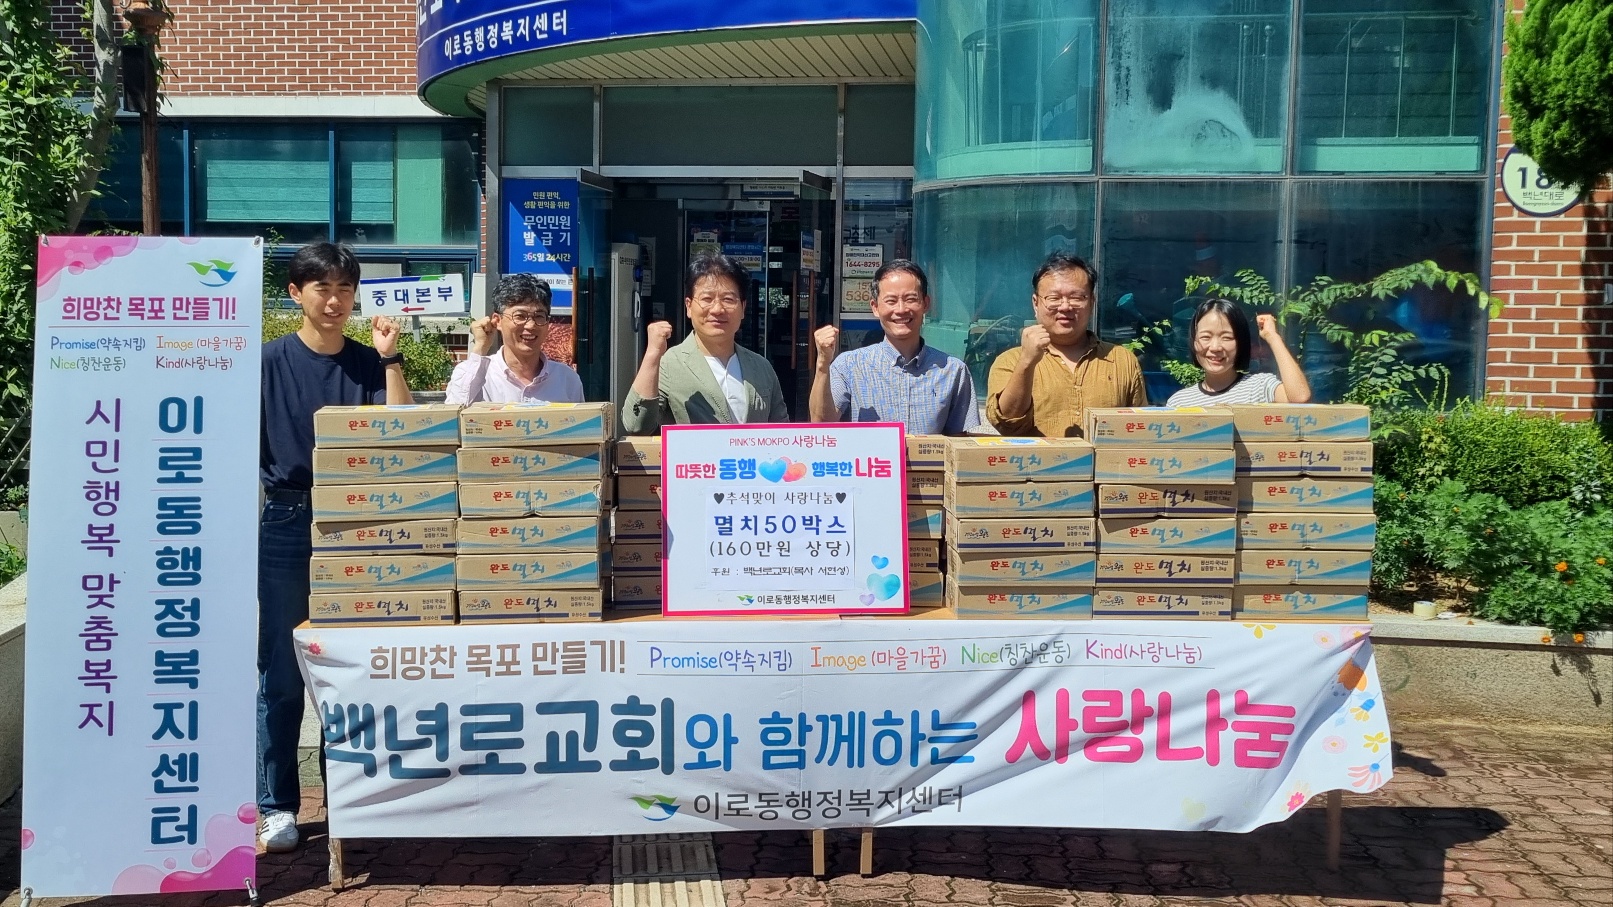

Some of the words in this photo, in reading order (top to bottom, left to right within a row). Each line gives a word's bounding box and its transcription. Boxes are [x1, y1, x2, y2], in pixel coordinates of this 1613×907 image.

[445, 9, 567, 60] 이로동행정복지센터
[1523, 191, 1564, 200] 백년대로
[524, 201, 536, 209] 생활
[537, 201, 556, 209] 편익을
[558, 201, 570, 209] 위한
[524, 216, 571, 229] 무인민원
[523, 252, 544, 262] 365일
[546, 253, 571, 262] 24시간
[372, 286, 453, 306] 중대본부
[62, 296, 122, 321] 희망찬
[128, 297, 166, 321] 목포
[172, 297, 236, 321] 만들기!
[50, 336, 146, 351] Promise(약속지킴)
[156, 336, 193, 351] Image
[196, 336, 247, 351] (마을가꿈)
[50, 356, 126, 372] Nice(칭찬운동)
[155, 356, 233, 371] Kind(사랑나눔)
[348, 420, 369, 430] 완도
[372, 418, 404, 436] 멸치
[494, 420, 513, 430] 완도
[516, 417, 548, 435] 멸치
[1126, 423, 1145, 432] 완도
[1148, 421, 1180, 438] 멸치
[1264, 416, 1283, 425] 완도
[1286, 414, 1317, 431] 멸치
[729, 438, 756, 447] PINK'S
[758, 437, 789, 446] MOKPO
[792, 435, 837, 448] 사랑나눔
[346, 457, 368, 467] 완도
[370, 454, 403, 472] 멸치
[491, 457, 511, 466] 완도
[513, 455, 546, 471] 멸치
[988, 456, 1007, 466] 완도
[1010, 453, 1041, 471] 멸치
[1127, 458, 1147, 467] 완도
[1150, 456, 1182, 473] 멸치
[1278, 452, 1298, 461] 완도
[1300, 450, 1330, 465] 멸치
[675, 463, 716, 479] 따뜻한
[719, 458, 756, 480] 동행
[812, 461, 853, 477] 행복한
[855, 457, 892, 478] 나눔
[81, 398, 121, 557] 시민행복
[346, 494, 367, 504] 완도
[370, 492, 402, 510] 멸치
[493, 492, 513, 501] 완도
[516, 490, 548, 506] 멸치
[726, 492, 776, 505] 추석맞이
[784, 491, 833, 505] 사랑나눔
[988, 491, 1008, 501] 완도
[1010, 489, 1042, 506] 멸치
[1138, 492, 1159, 504] 완도
[1162, 489, 1195, 507] 멸치
[1267, 486, 1287, 496] 완도
[1290, 484, 1322, 501] 멸치
[489, 527, 509, 537] 완도
[512, 525, 543, 542] 멸치
[714, 514, 847, 536] 멸치50박스
[1269, 523, 1288, 532] 완도
[1291, 521, 1323, 537] 멸치
[356, 530, 377, 541] 완도
[379, 529, 411, 544] 멸치
[1002, 528, 1022, 538] 완도
[1024, 527, 1053, 541] 멸치
[1130, 528, 1149, 537] 완도
[1151, 526, 1184, 543] 멸치
[710, 540, 791, 558] (160만원
[806, 540, 850, 558] 상당)
[344, 566, 365, 576] 완도
[368, 564, 400, 581] 멸치
[490, 564, 510, 573] 완도
[513, 562, 544, 579] 멸치
[710, 567, 730, 576] 후원
[990, 561, 1010, 570] 완도
[1012, 559, 1044, 576] 멸치
[1134, 562, 1155, 574] 완도
[1158, 560, 1191, 577] 멸치
[1266, 560, 1286, 568] 완도
[1288, 558, 1319, 574] 멸치
[354, 602, 375, 612] 완도
[377, 600, 408, 616] 멸치
[504, 598, 525, 609] 완도
[526, 597, 557, 612] 멸치
[757, 594, 835, 605] 이로동행정복지센터
[988, 594, 1007, 604] 완도
[1010, 592, 1041, 609] 멸치
[1137, 596, 1157, 605] 완도
[1158, 595, 1188, 609] 멸치
[1263, 594, 1282, 603] 완도
[1284, 593, 1316, 609] 멸치
[151, 395, 204, 845] 이로동행정복지센터
[78, 573, 121, 736] 맞춤복지
[370, 644, 458, 681] 희망찬
[466, 643, 521, 678] 목포
[531, 640, 626, 677] 만들기!
[649, 646, 793, 672] Promise(약속지킴)
[810, 646, 866, 671] Image
[871, 645, 947, 671] (마을가꿈)
[960, 640, 1071, 666] Nice(칭찬운동)
[1085, 639, 1202, 665] Kind(사랑나눔)
[758, 709, 979, 771] 함께하는
[1004, 688, 1296, 769] 사랑나눔
[693, 785, 963, 821] 이로동행정복지센터
